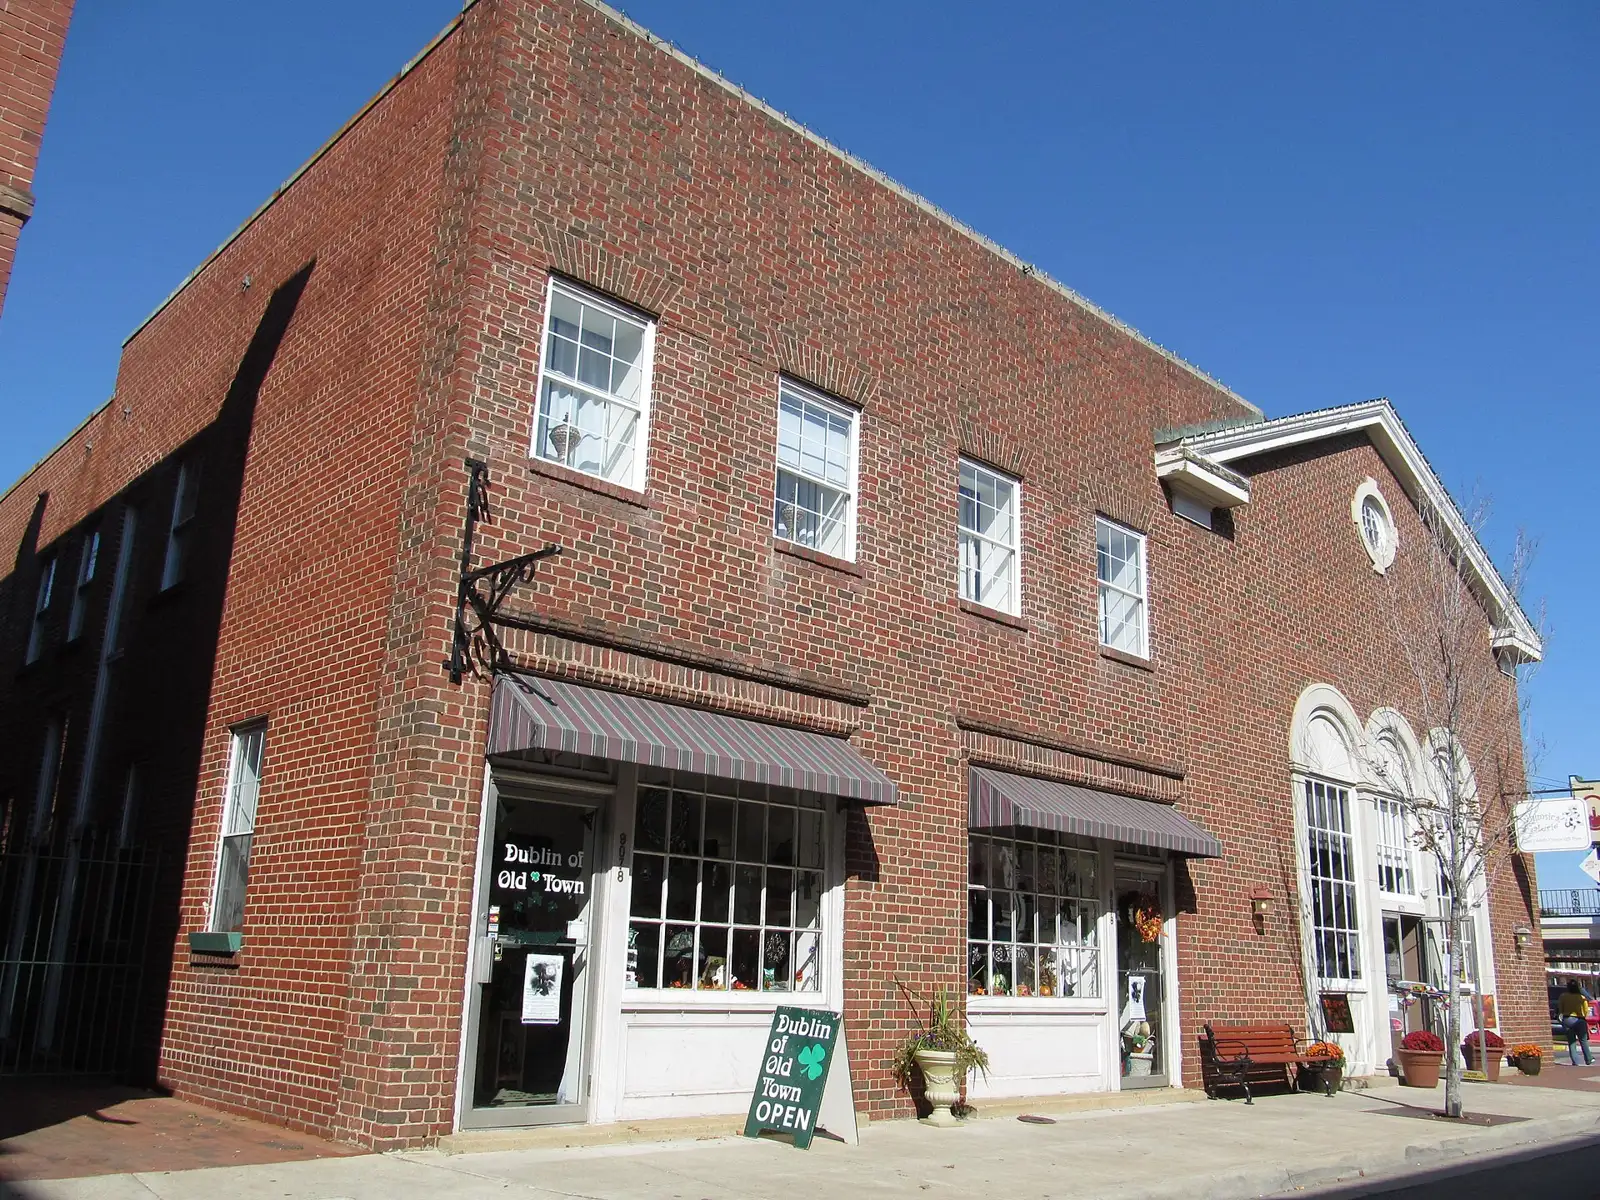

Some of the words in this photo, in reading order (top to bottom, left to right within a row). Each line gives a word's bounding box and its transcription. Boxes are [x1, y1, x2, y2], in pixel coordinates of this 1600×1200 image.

[504, 843, 562, 866] Dublin
[568, 852, 584, 868] of
[498, 870, 527, 890] Old
[543, 873, 584, 895] Town
[776, 1014, 831, 1040] Dublin
[771, 1035, 789, 1054] of
[765, 1055, 793, 1077] Old
[762, 1076, 802, 1103] Town
[755, 1100, 812, 1131] OPEN
